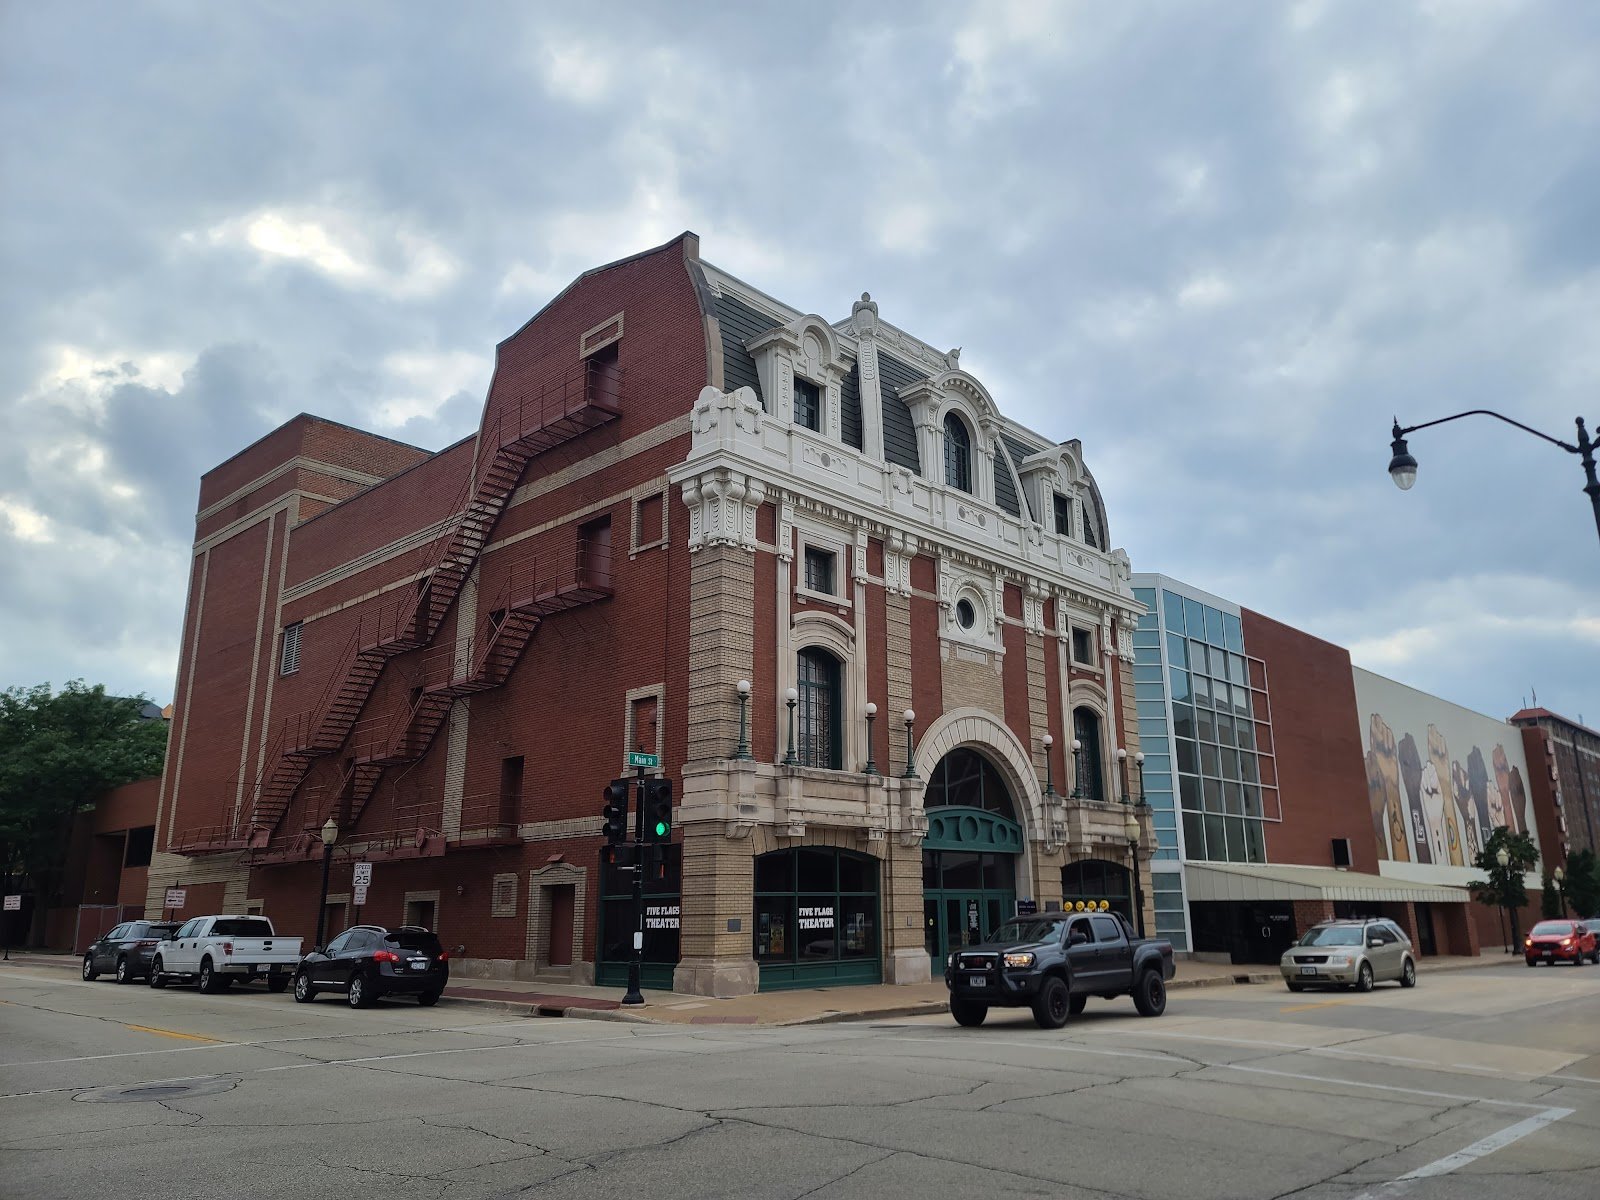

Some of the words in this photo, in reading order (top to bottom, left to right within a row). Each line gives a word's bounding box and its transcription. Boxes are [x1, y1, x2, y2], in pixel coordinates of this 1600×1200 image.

[634, 755, 646, 764] Main
[648, 757, 653, 765] St
[354, 875, 369, 885] 25
[646, 906, 660, 916] FIVE
[660, 906, 680, 915] FLAGS
[798, 907, 813, 916] FIVE
[814, 907, 834, 916] FLAGS
[645, 917, 680, 929] THEATER
[798, 917, 834, 929] THEATER
